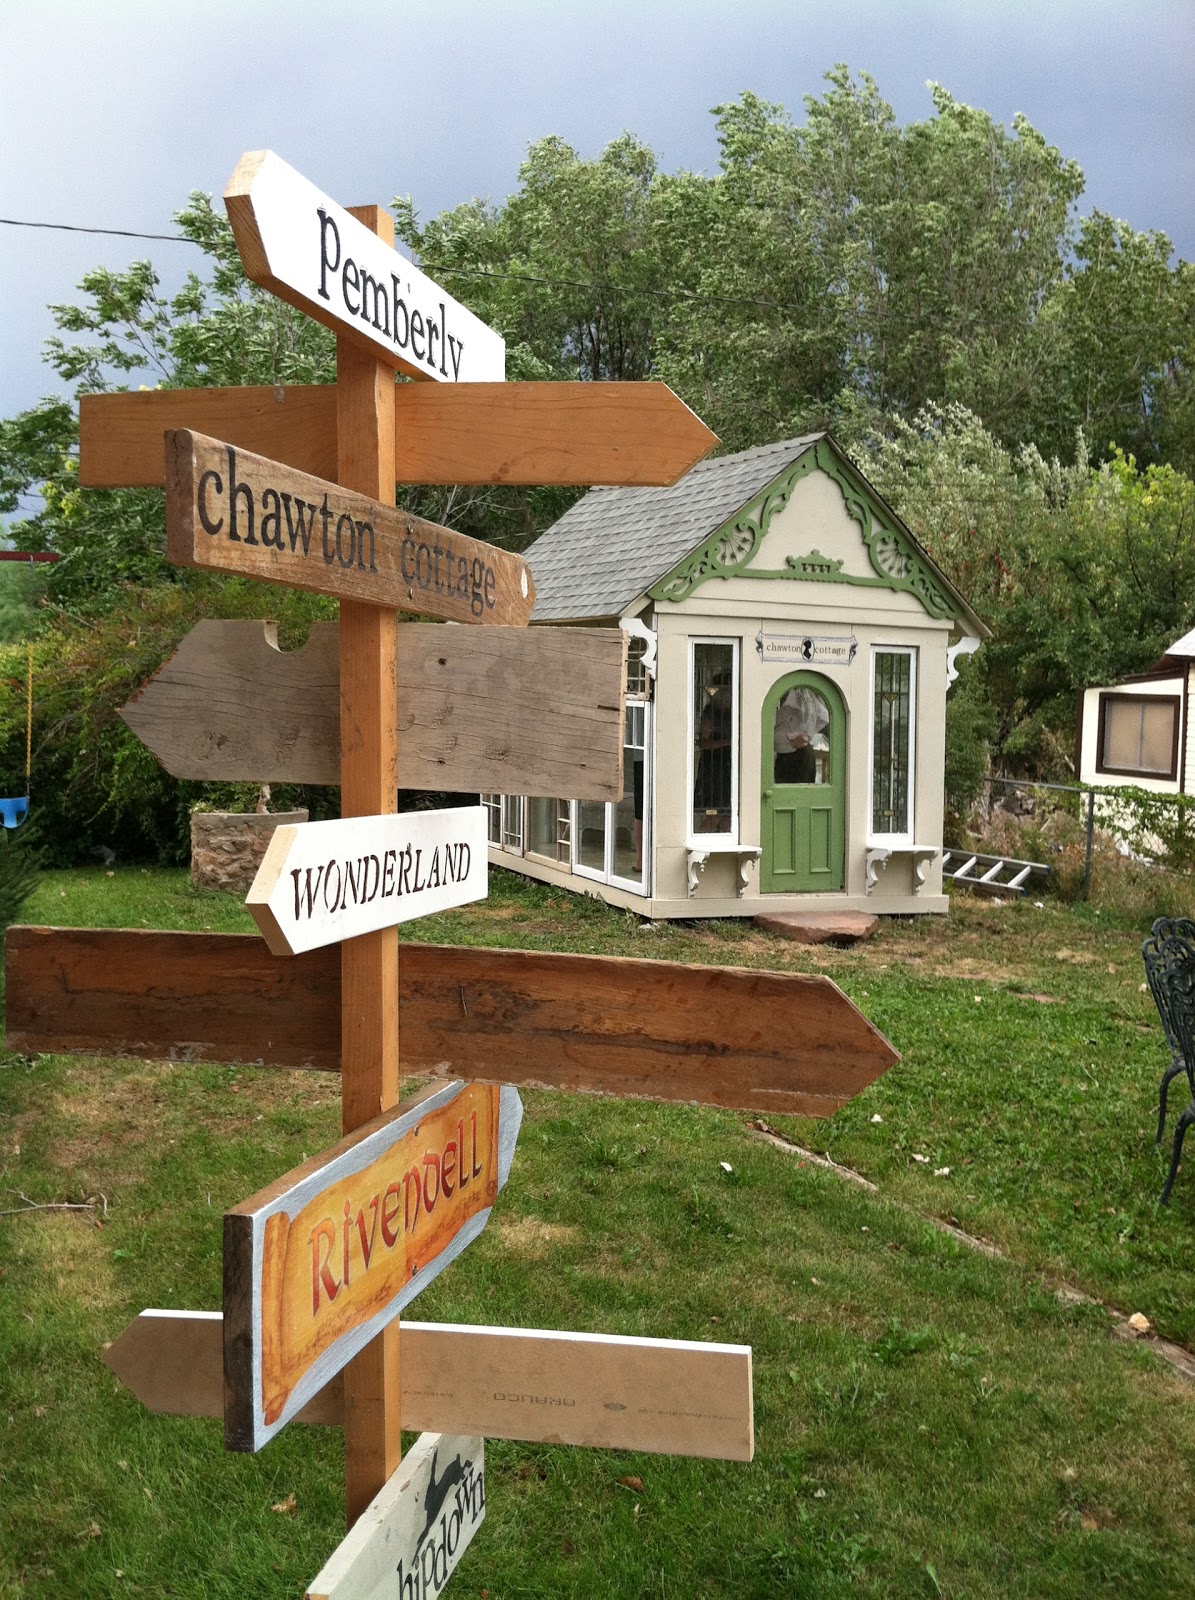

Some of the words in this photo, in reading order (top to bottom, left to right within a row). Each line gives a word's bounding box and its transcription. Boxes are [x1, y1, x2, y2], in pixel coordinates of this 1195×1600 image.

[316, 205, 464, 383] Pemberly
[197, 445, 377, 574] chawton
[400, 533, 497, 618] cottage
[766, 642, 801, 653] chawton
[814, 645, 846, 656] cottage
[290, 842, 471, 921] WONDERLAND
[493, 1392, 576, 1407] ARAUCO
